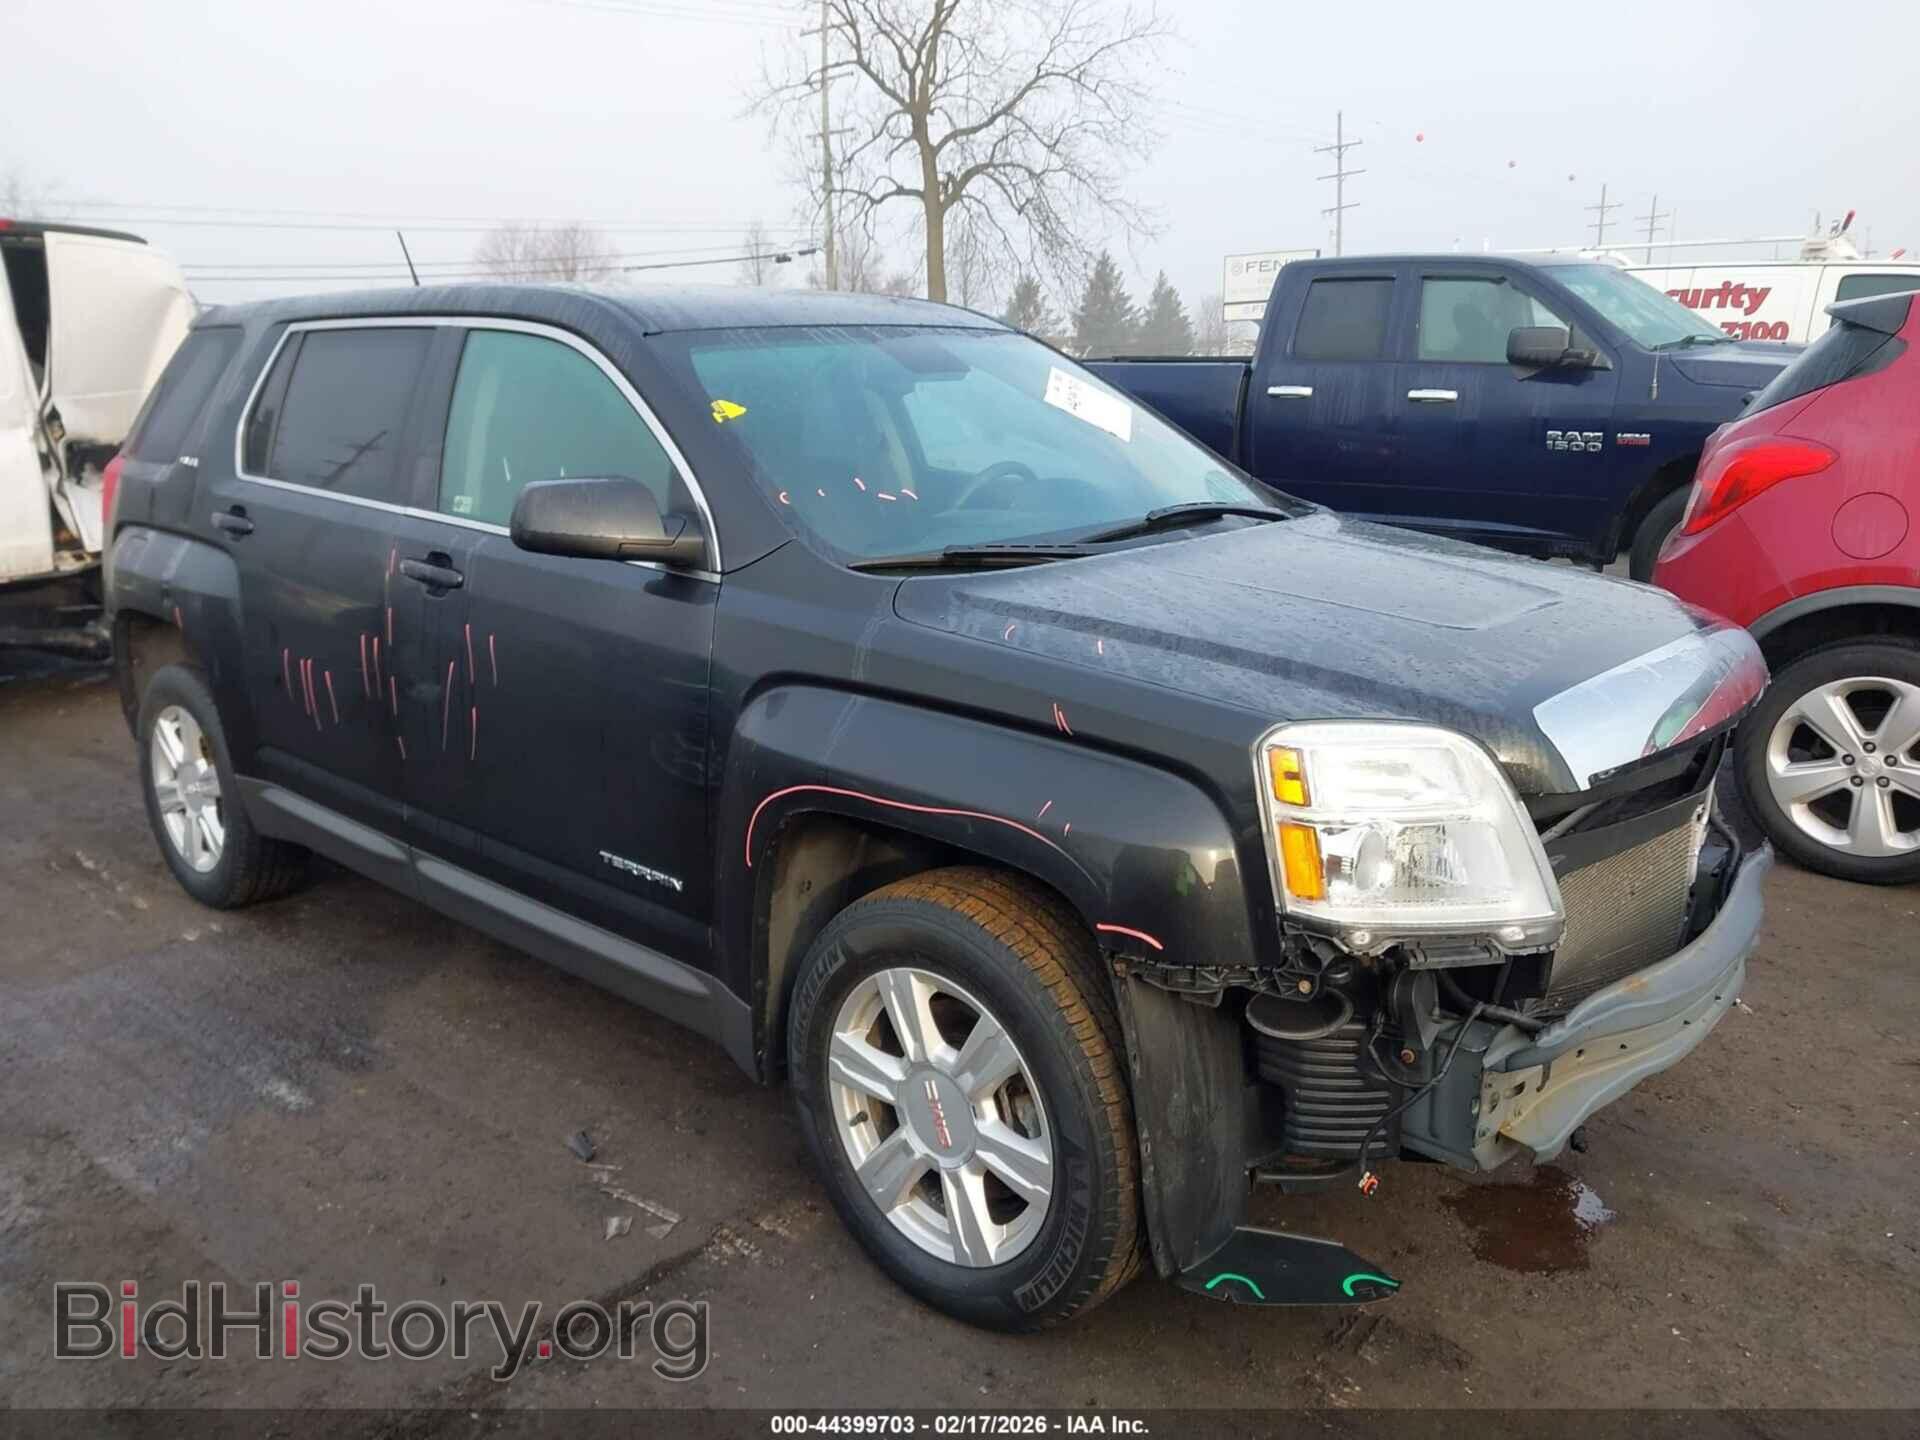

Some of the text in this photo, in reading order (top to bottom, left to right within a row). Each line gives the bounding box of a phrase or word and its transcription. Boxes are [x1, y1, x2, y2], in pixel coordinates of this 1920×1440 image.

[1546, 430, 1604, 442] RAM
[1546, 440, 1603, 452] 1500
[599, 850, 683, 892] TERRAIN
